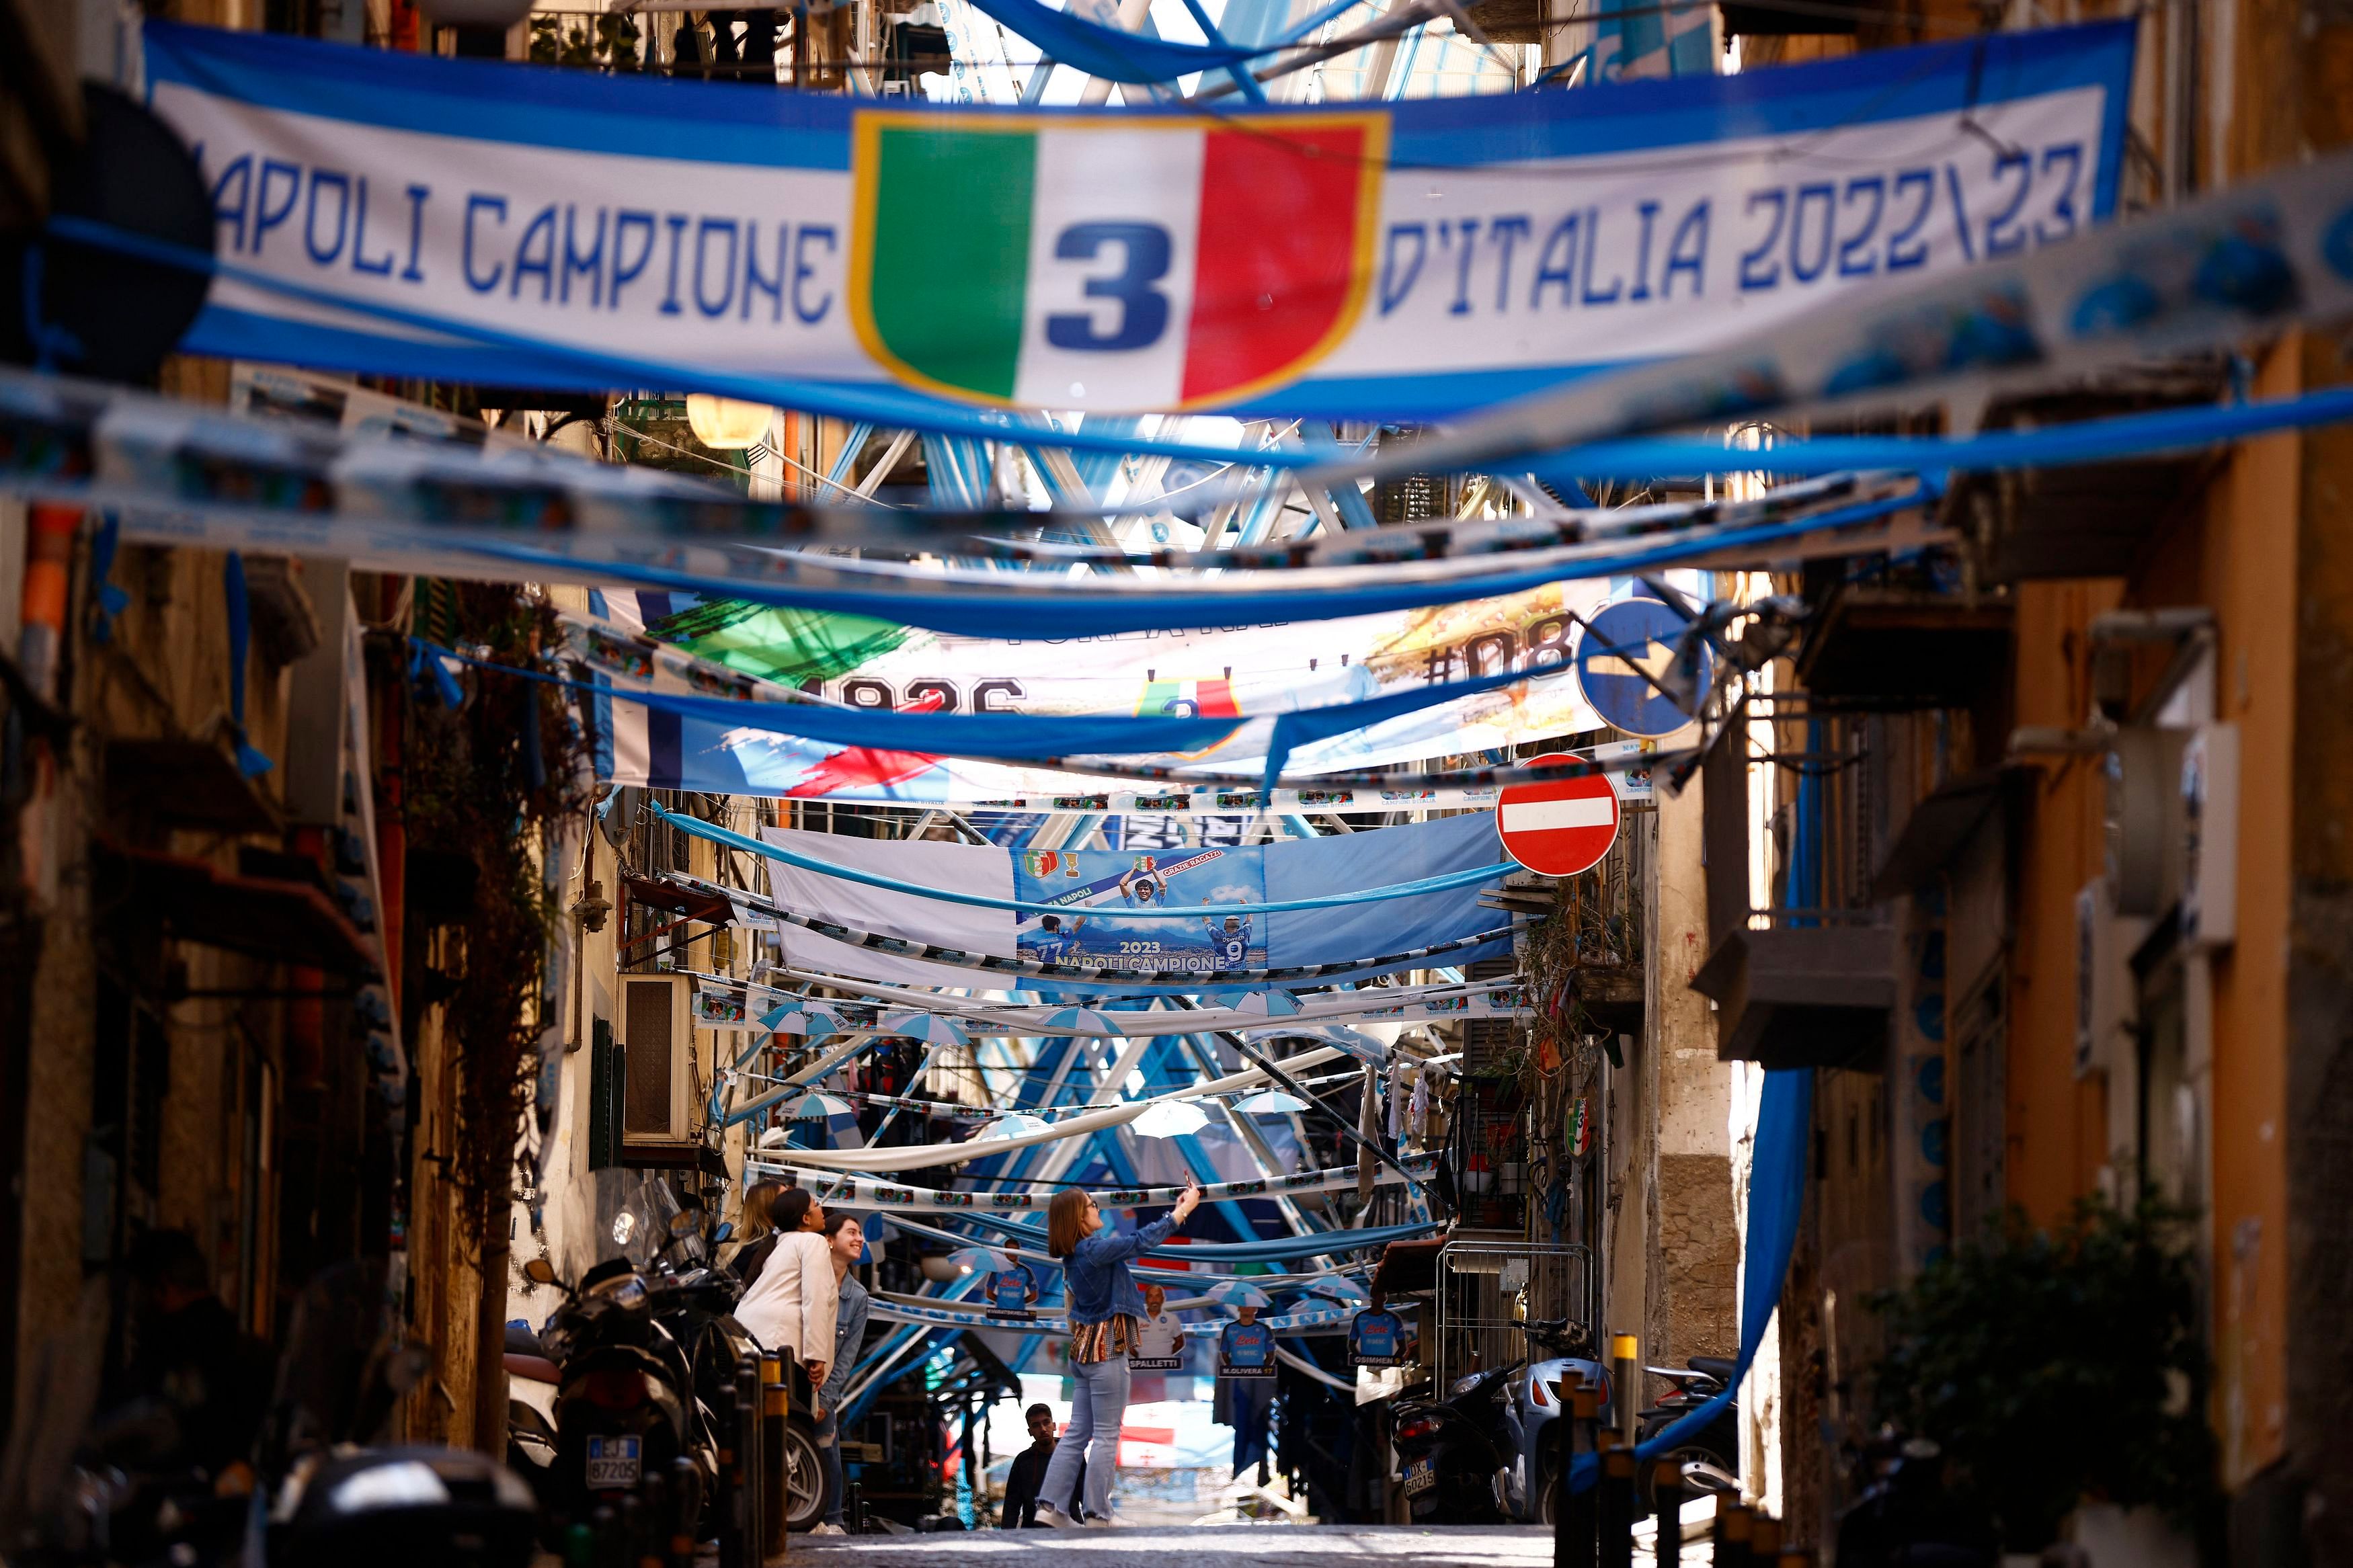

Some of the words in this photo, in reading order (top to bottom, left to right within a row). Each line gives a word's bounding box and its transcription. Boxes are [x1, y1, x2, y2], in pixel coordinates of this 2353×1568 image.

[202, 143, 432, 283] APOLI
[463, 193, 837, 324] CAMPIONE
[1378, 197, 1712, 317] D'ITALIA
[1046, 219, 1172, 350] 3
[1033, 859, 1043, 872] 2
[1164, 861, 1190, 876] GRAZIE
[1189, 850, 1222, 866] RAGAZZI
[1060, 887, 1092, 905] NAPOLI
[1037, 942, 1063, 961] 77
[1120, 942, 1161, 954] 2023
[1227, 941, 1242, 962] 9
[1055, 956, 1123, 969] NAPOLI
[1128, 956, 1226, 971] CAMPIONE
[1578, 1112, 1585, 1128] 3
[1406, 1472, 1433, 1493] 60215
